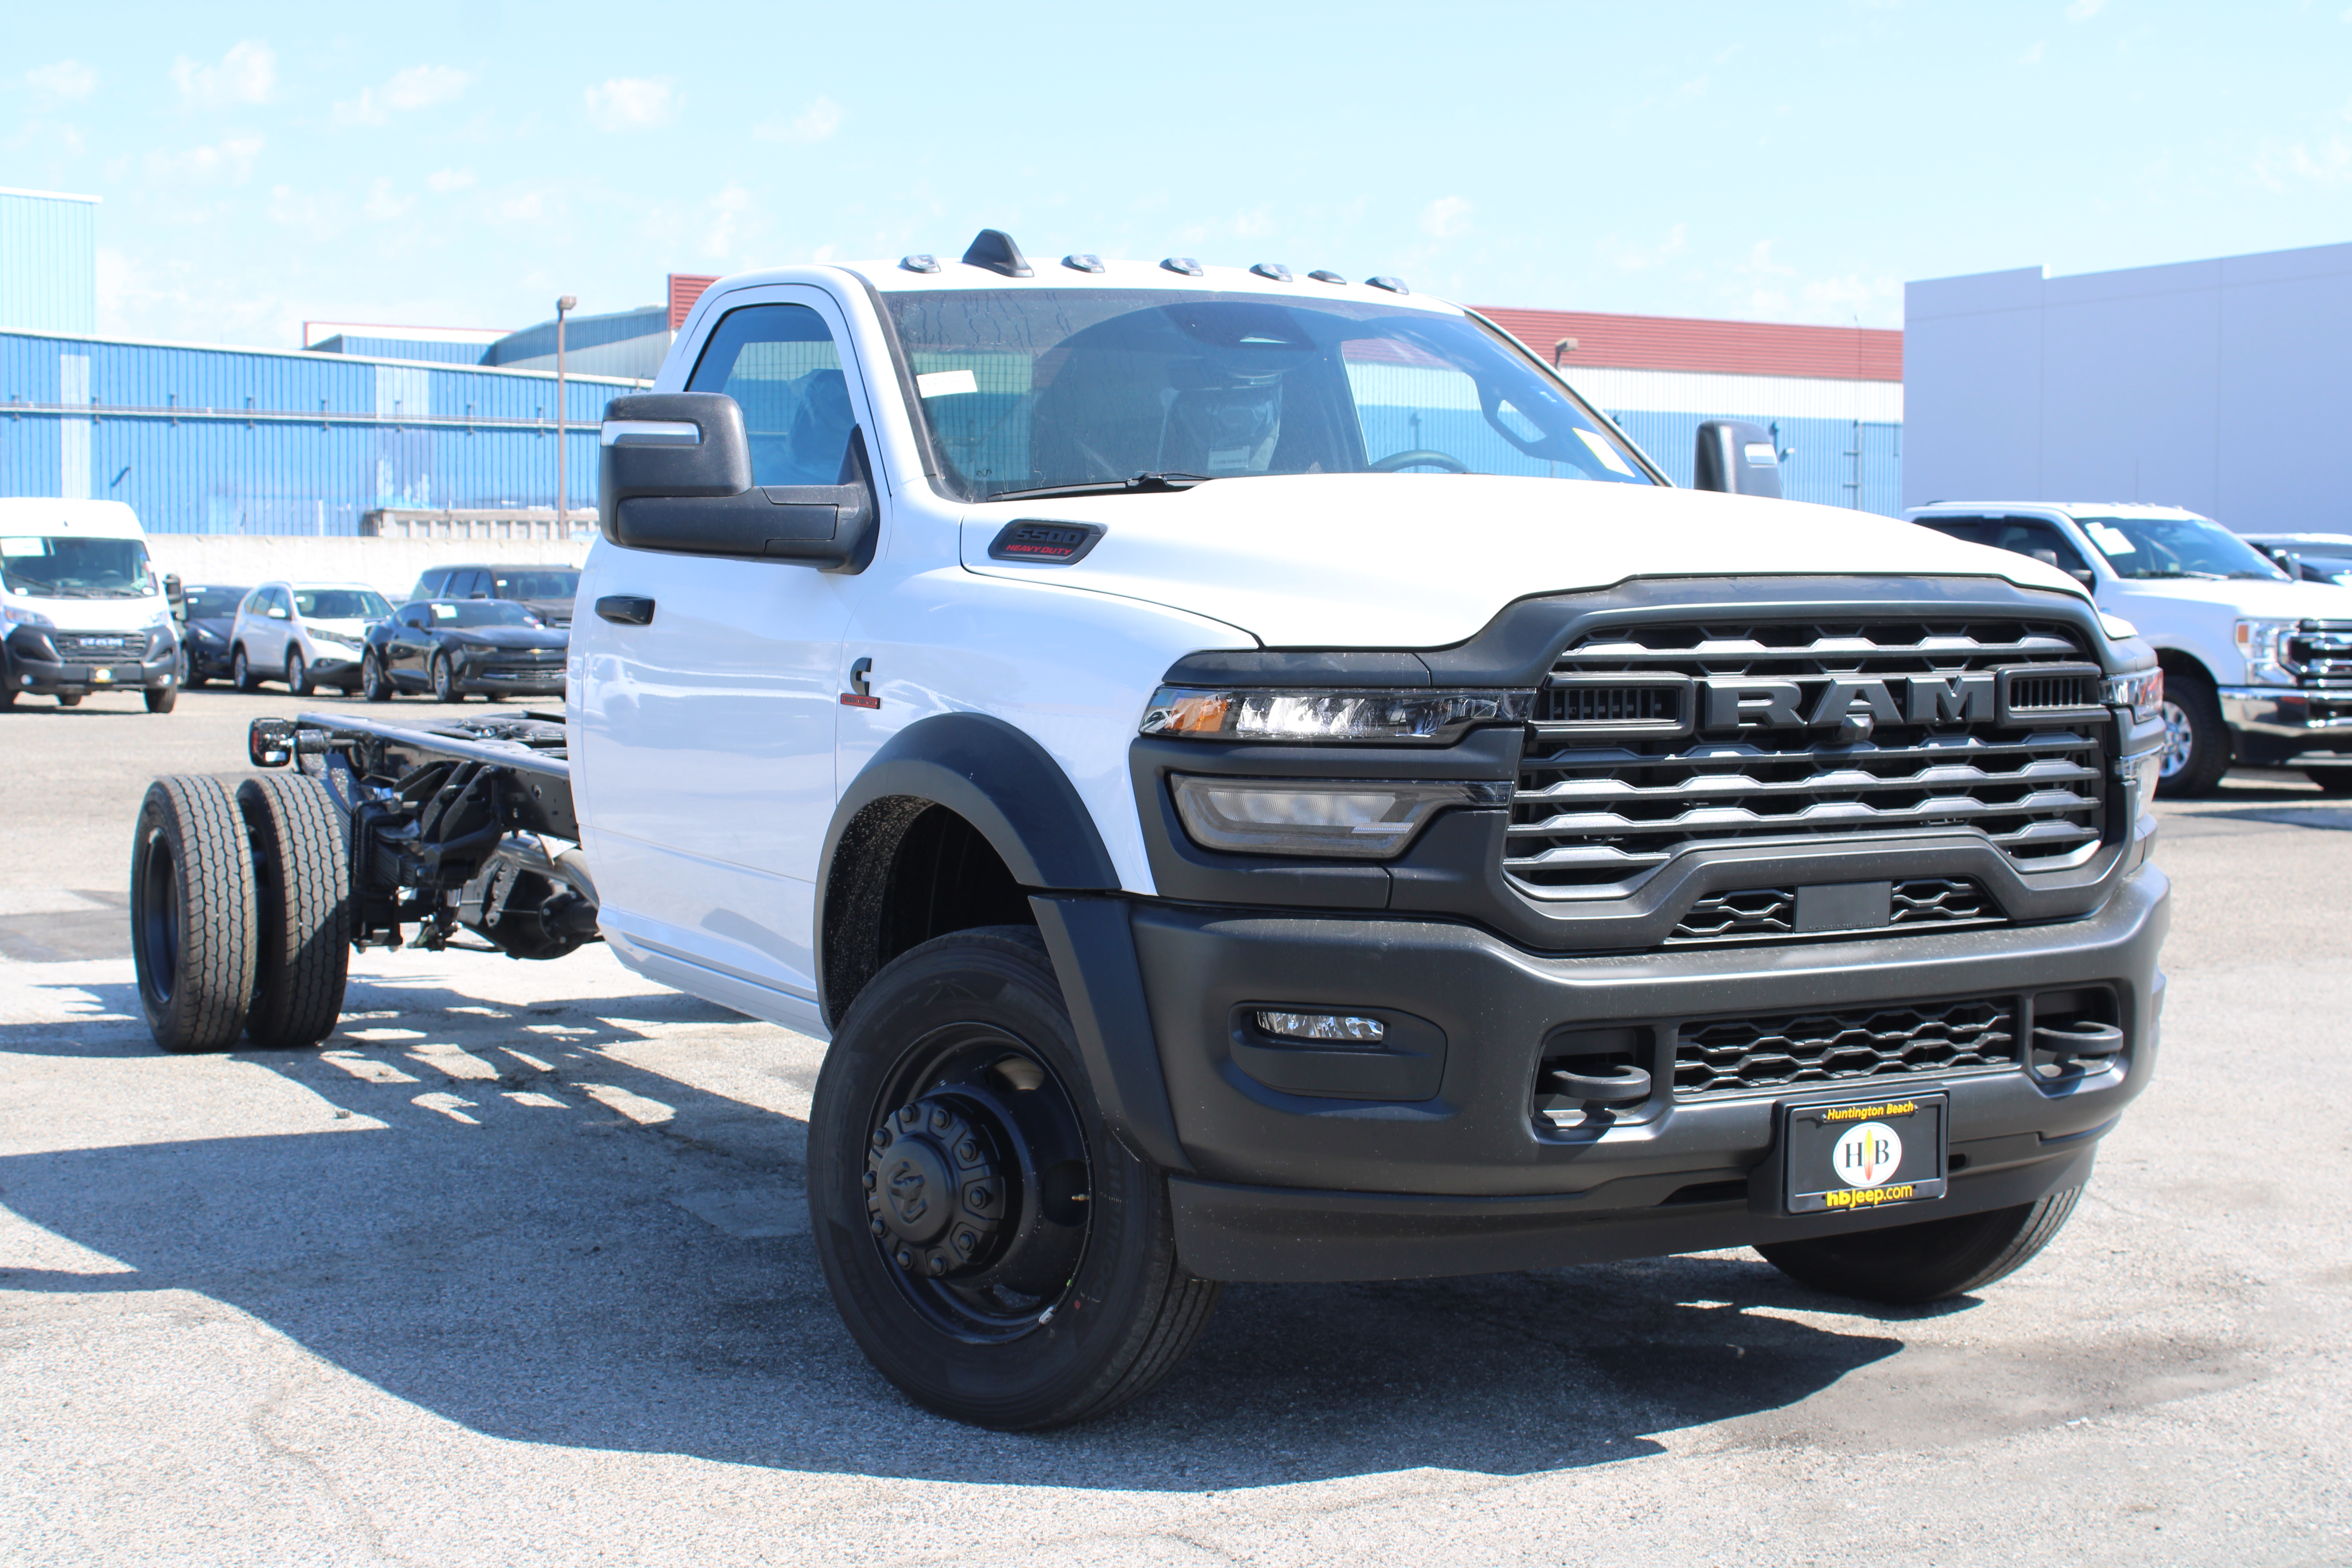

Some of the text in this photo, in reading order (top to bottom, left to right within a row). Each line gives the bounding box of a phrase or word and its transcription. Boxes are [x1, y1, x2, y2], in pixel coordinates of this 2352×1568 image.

[1015, 529, 1081, 544] 5500
[1006, 544, 1073, 555] HEAVY DUTY
[1706, 675, 1995, 729] RAM
[1827, 1100, 1914, 1120] Huntington Beach
